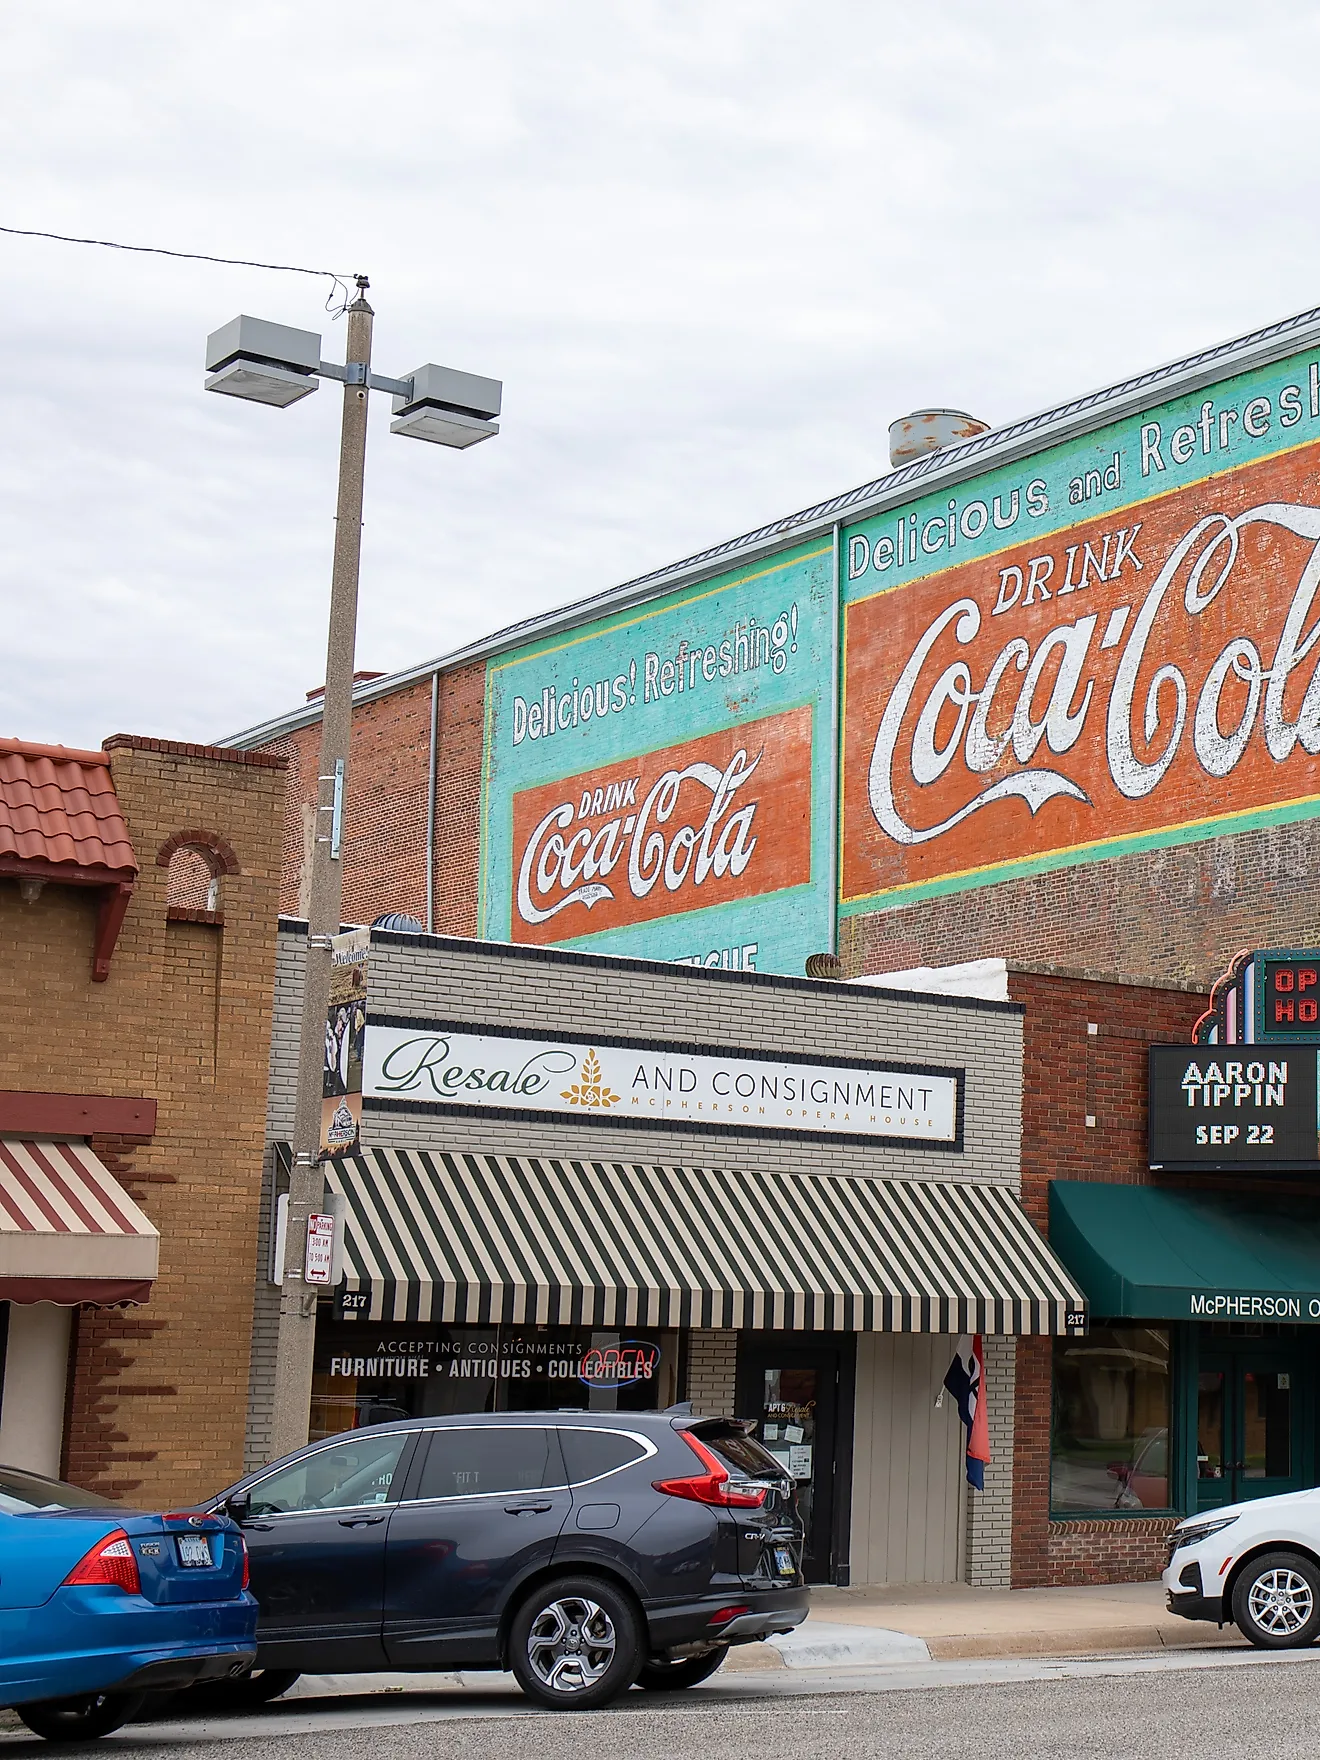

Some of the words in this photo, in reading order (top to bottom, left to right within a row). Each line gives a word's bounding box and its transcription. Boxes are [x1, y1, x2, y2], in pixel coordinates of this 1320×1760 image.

[848, 478, 1050, 581] Delicious
[1068, 451, 1121, 507] and
[991, 523, 1146, 616] DRINK
[512, 657, 636, 747] Delicious!
[643, 602, 799, 704] Refreshing!
[577, 776, 640, 820] DRINK
[516, 745, 765, 925] Coca-Cola
[374, 1034, 577, 1097] Resale
[631, 1064, 698, 1093] AND
[712, 1071, 935, 1112] CONSIGNMENT
[1181, 1061, 1288, 1084] AARON
[1181, 1083, 1285, 1107] TIPPIN
[630, 1096, 767, 1114] MCPHERSON
[785, 1108, 851, 1121] OPERA
[870, 1115, 934, 1127] HOUSE
[1195, 1124, 1240, 1145] SEP
[1246, 1124, 1274, 1145] 22
[316, 1221, 333, 1232] PARKING
[342, 1294, 367, 1308] 217
[1190, 1295, 1300, 1317] McPHERSON
[1067, 1314, 1085, 1325] 217
[377, 1341, 461, 1353] ACCEPTING
[468, 1343, 583, 1355] CONSIGNMENTS
[331, 1357, 429, 1377] FURNITURE
[449, 1359, 531, 1379] ANTIQUES
[548, 1360, 653, 1379] COLLECTIBLES
[582, 1349, 655, 1380] OPEN
